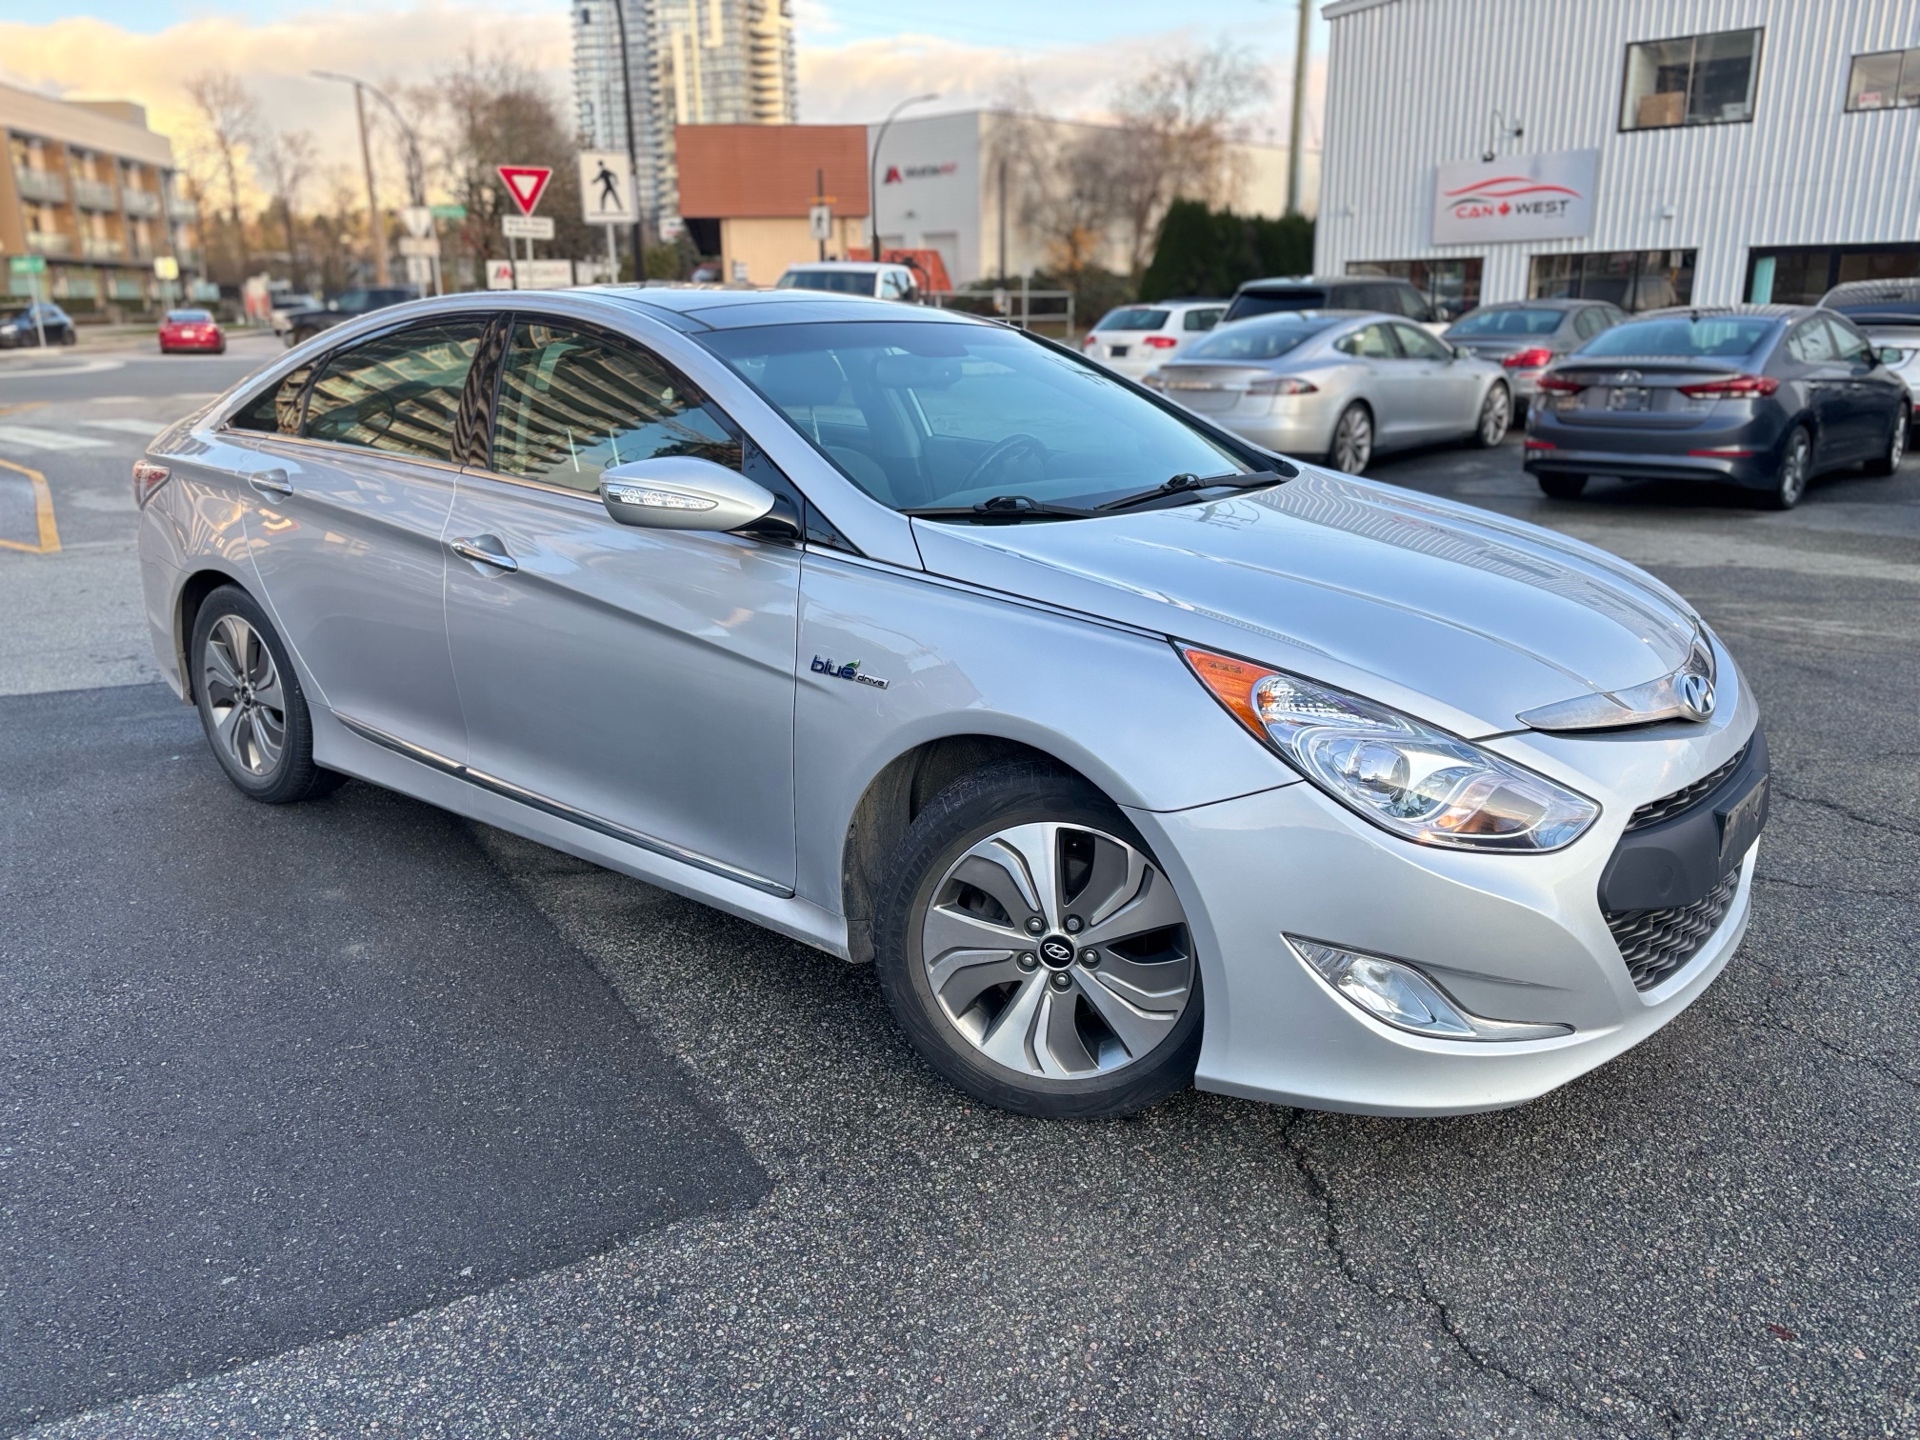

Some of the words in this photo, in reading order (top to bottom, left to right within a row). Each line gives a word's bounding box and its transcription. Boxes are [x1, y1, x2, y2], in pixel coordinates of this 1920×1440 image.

[1455, 204, 1494, 219] CAN
[1515, 199, 1570, 214] WEST
[810, 654, 857, 681] blue
[857, 674, 885, 687] drive
